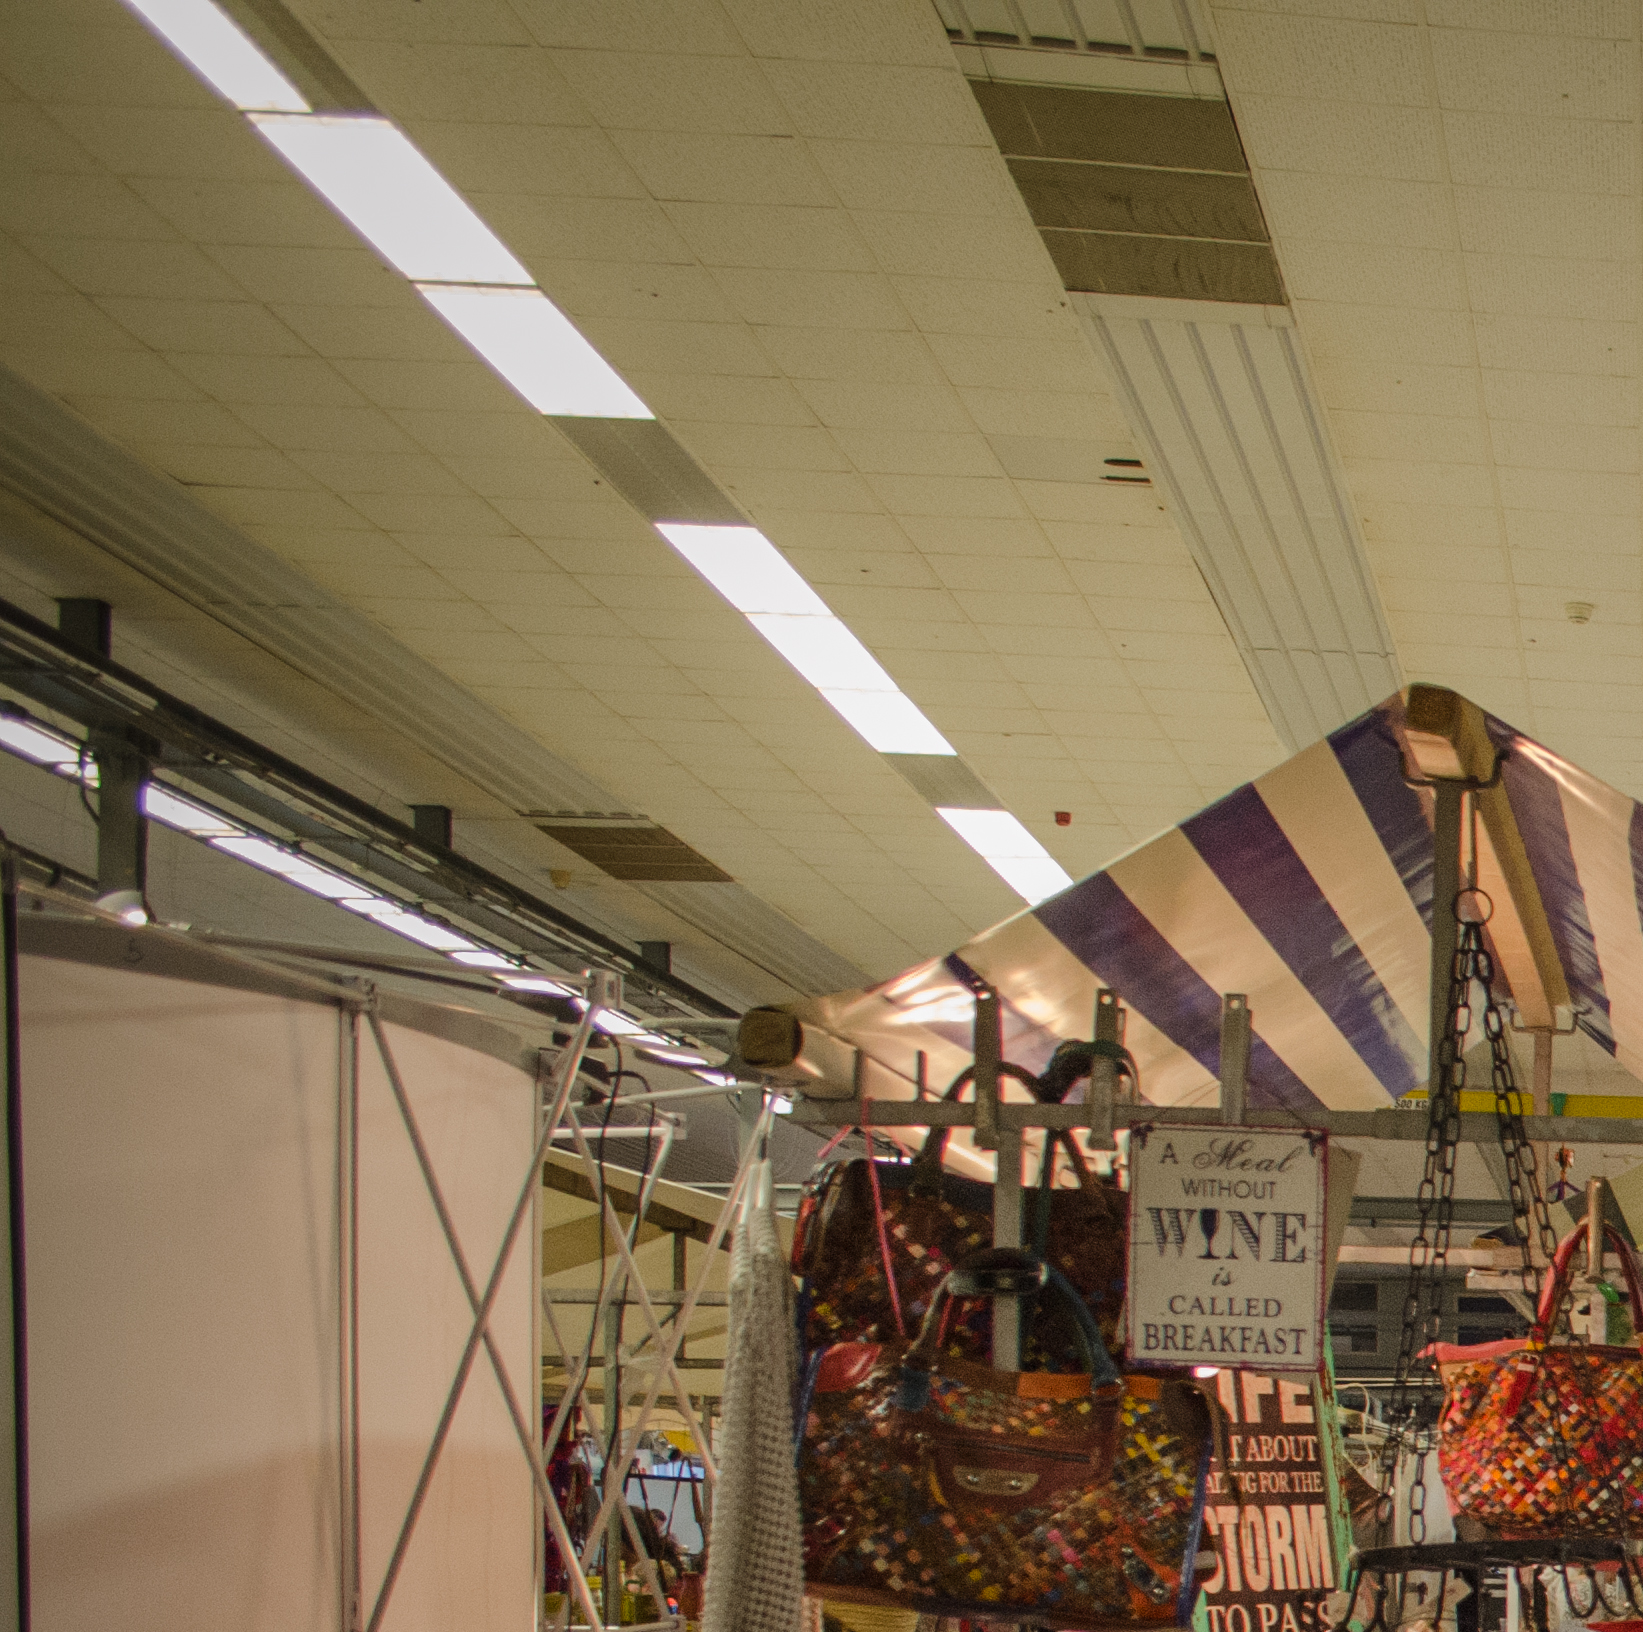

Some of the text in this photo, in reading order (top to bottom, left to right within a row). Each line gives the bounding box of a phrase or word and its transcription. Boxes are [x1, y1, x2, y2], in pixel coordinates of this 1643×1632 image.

[1160, 1137, 1304, 1173] A Meal
[1181, 1178, 1276, 1199] WITHOUT
[1211, 1267, 1235, 1287] is
[1168, 1295, 1283, 1318] CALLED
[1142, 1323, 1307, 1355] BREAKFAST
[1217, 1369, 1315, 1424] IFE
[1246, 1434, 1319, 1462] ABOUT
[1258, 1471, 1291, 1493] FOR
[1290, 1471, 1324, 1493] THE
